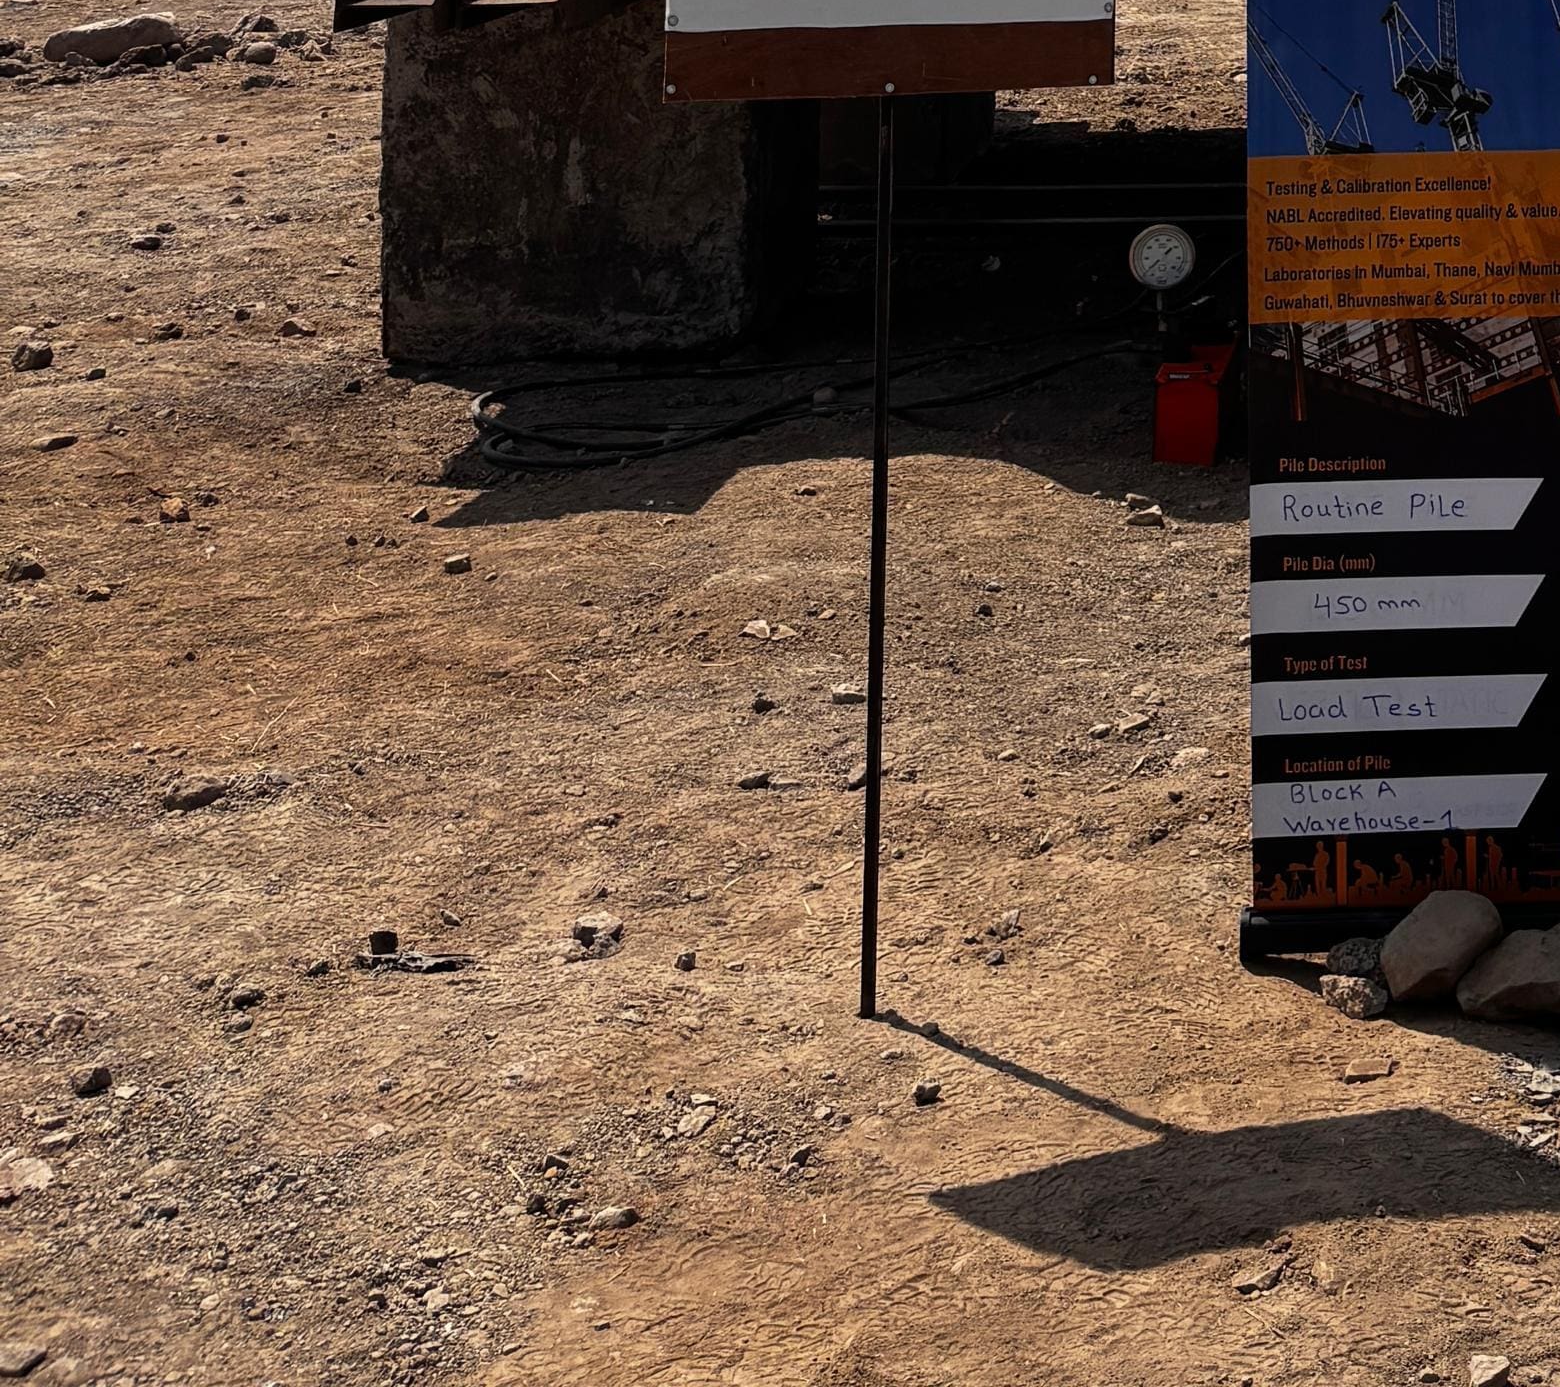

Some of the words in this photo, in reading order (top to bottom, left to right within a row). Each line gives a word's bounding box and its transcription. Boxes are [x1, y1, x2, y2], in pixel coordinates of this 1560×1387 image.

[1266, 181, 1317, 198] Testing
[1320, 181, 1334, 194] &
[1336, 179, 1411, 193] Calibration
[1416, 176, 1491, 192] Excellence!
[1266, 209, 1306, 224] NABL
[1308, 207, 1384, 223] Accredited.
[1390, 205, 1452, 223] Elevating
[1456, 205, 1502, 221] quality
[1506, 203, 1518, 219] &
[1266, 237, 1300, 252] 750+
[1305, 235, 1364, 251] Methods
[1376, 233, 1404, 249] 175+
[1410, 233, 1461, 250] Experts
[1264, 266, 1350, 283] Laboratories
[1354, 265, 1367, 280] in
[1372, 263, 1430, 280] Mumbai,
[1434, 262, 1480, 278] Thane,
[1484, 261, 1516, 277] Navi
[1264, 294, 1333, 311] Guwahati,
[1337, 292, 1430, 309] Bhuvneshwar
[1434, 291, 1446, 307] &
[1450, 290, 1488, 306] Surat
[1492, 291, 1505, 305] to
[1508, 292, 1546, 305] cover
[1279, 458, 1304, 473] Pile
[1308, 456, 1386, 473] Description
[1282, 494, 1384, 522] Routine
[1283, 557, 1308, 572] Pile
[1312, 556, 1335, 571] Dia
[1340, 553, 1376, 573] (mm)
[1314, 593, 1367, 619] 450
[1378, 596, 1421, 610] mm
[1284, 657, 1318, 675] Type
[1320, 655, 1335, 671] of
[1338, 655, 1368, 670] Test
[1278, 696, 1348, 721] Load
[1362, 695, 1438, 718] Test
[1285, 757, 1344, 774] Location
[1348, 756, 1362, 771] of
[1365, 755, 1391, 770] Pile
[1378, 781, 1396, 799] A
